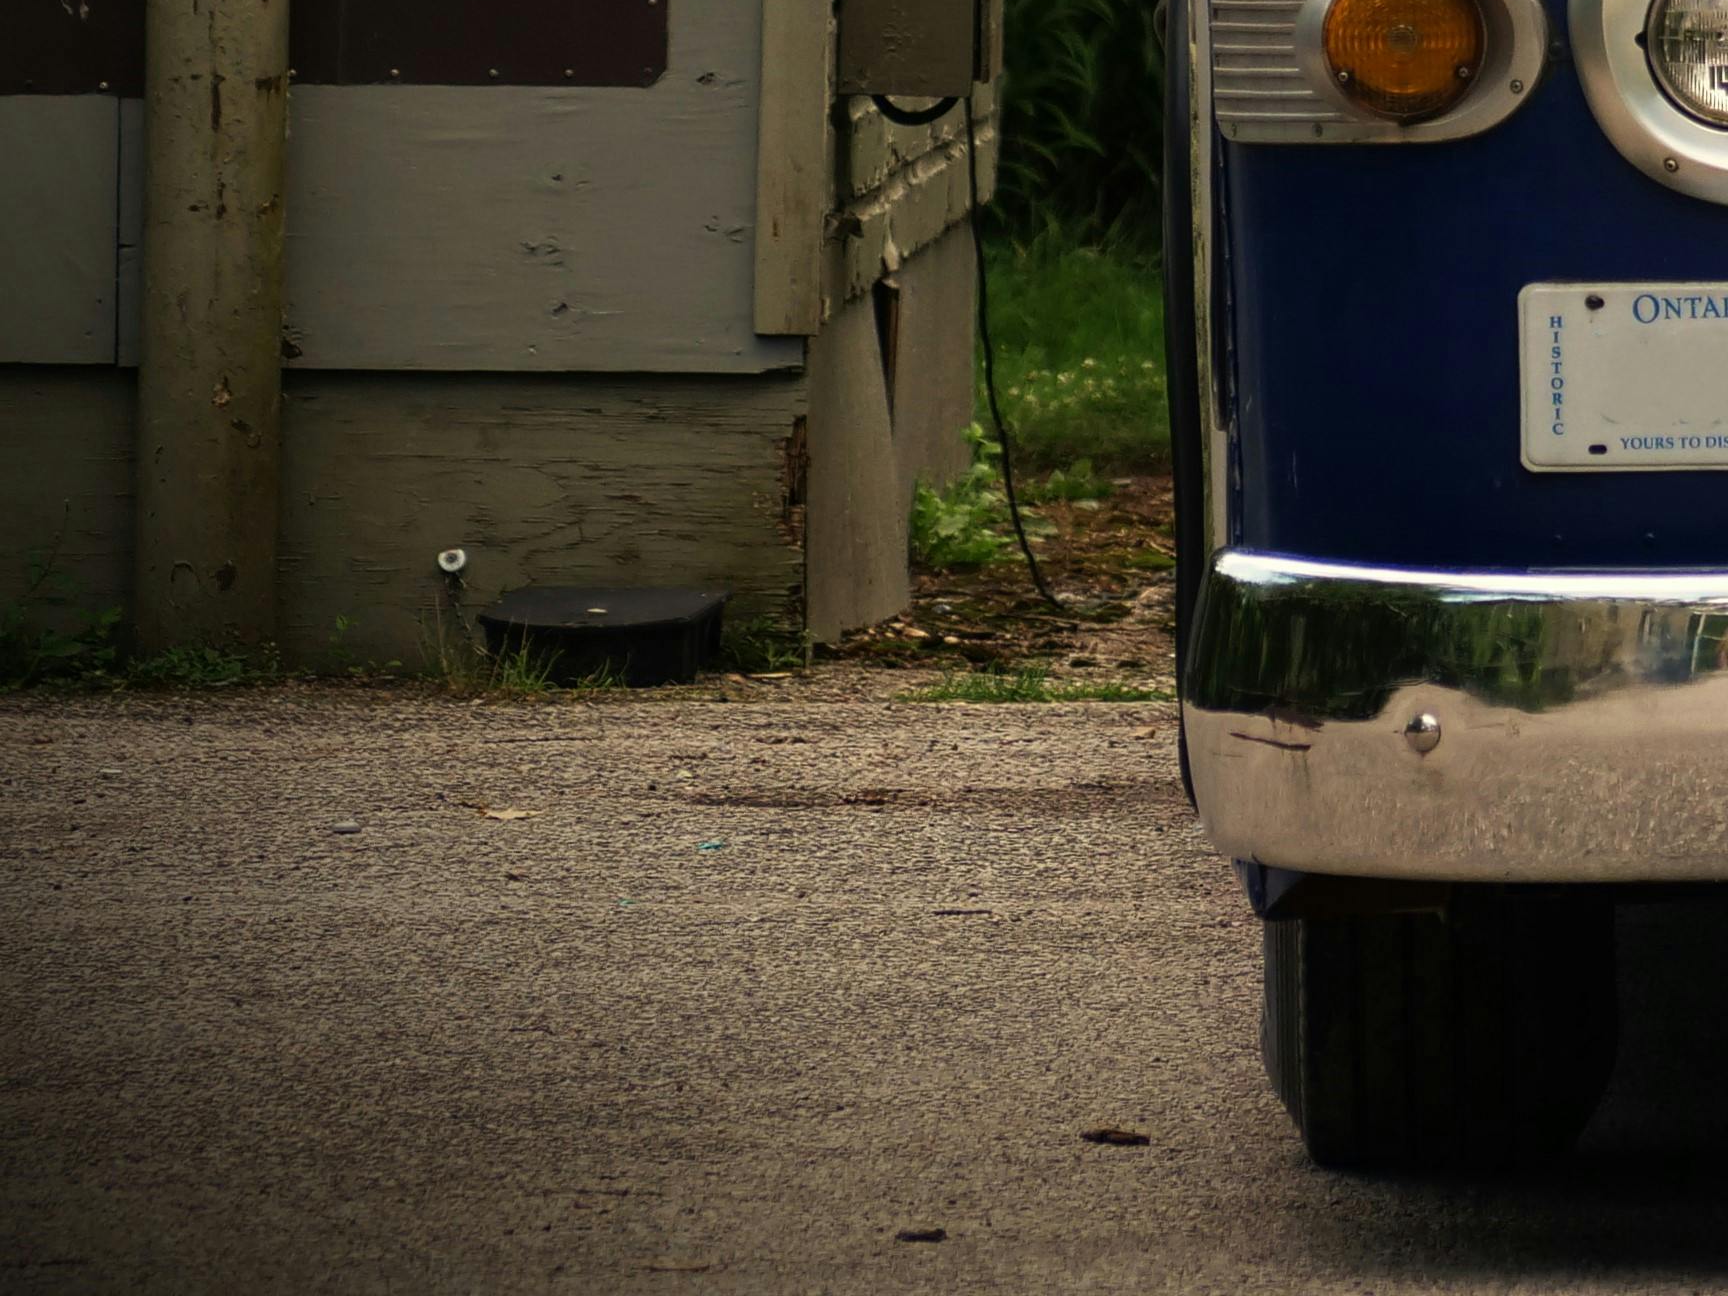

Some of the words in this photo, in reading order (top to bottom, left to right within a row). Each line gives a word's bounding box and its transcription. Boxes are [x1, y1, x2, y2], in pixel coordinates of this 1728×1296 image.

[1549, 316, 1564, 435] HISTORIC
[1620, 436, 1674, 450] YOURS
[1679, 436, 1700, 449] TO
